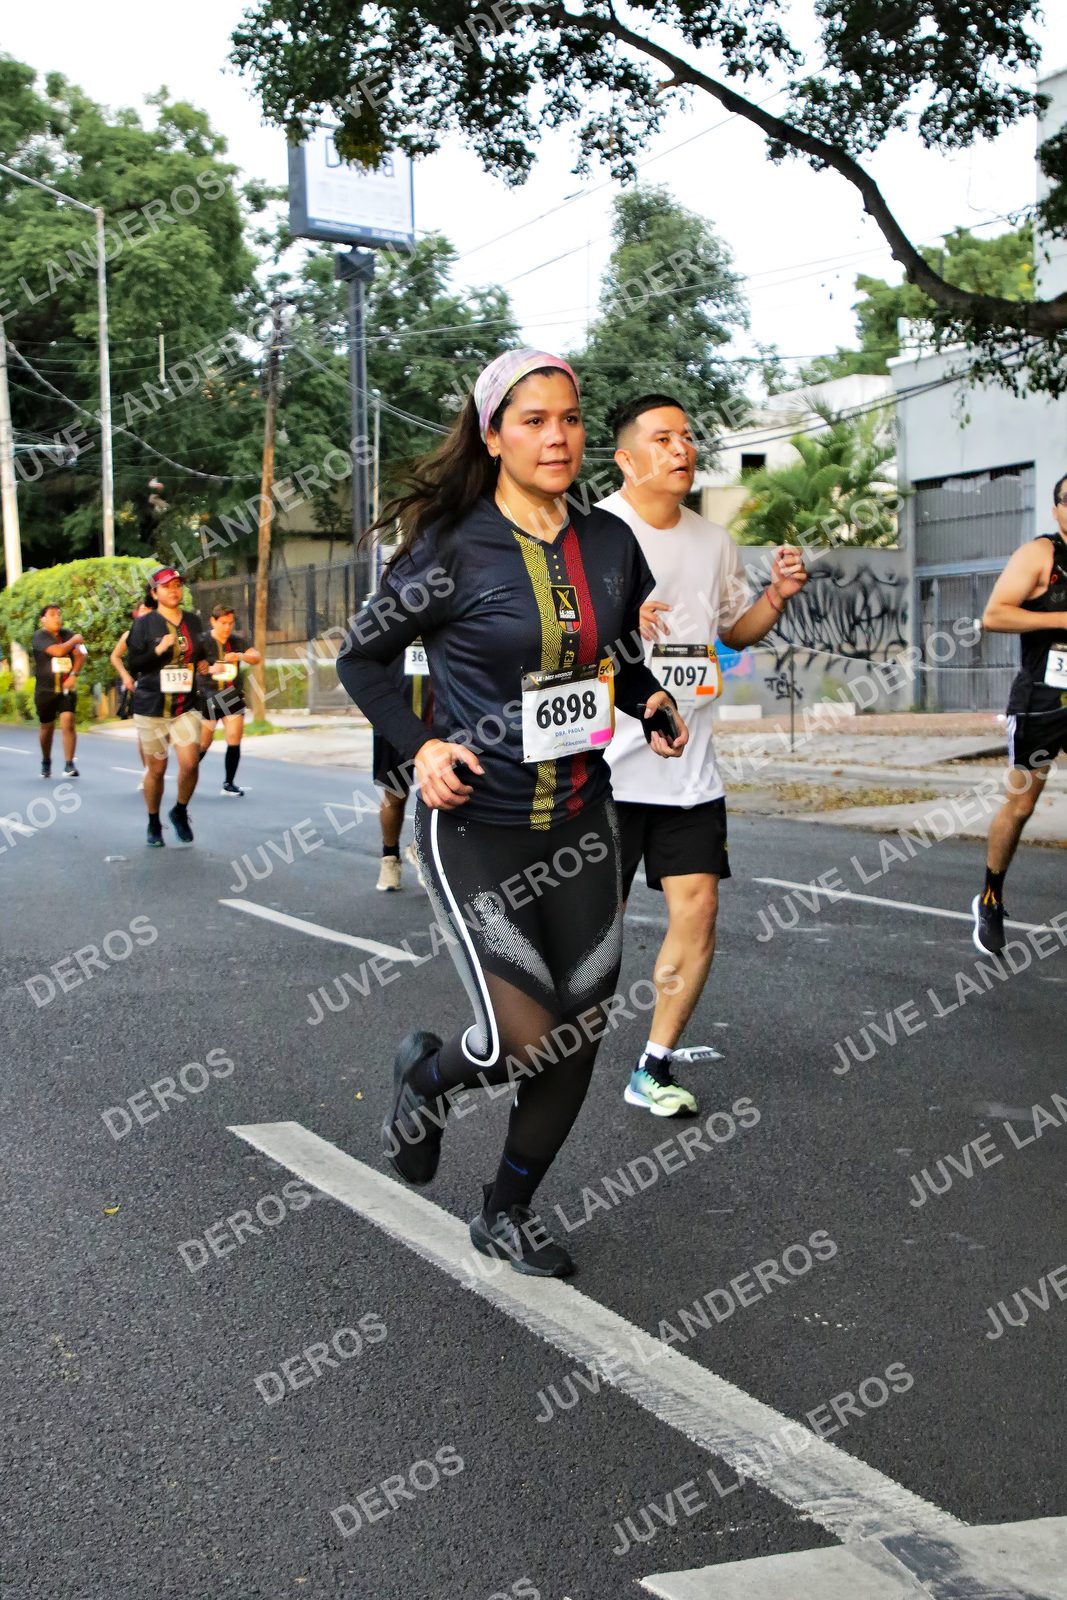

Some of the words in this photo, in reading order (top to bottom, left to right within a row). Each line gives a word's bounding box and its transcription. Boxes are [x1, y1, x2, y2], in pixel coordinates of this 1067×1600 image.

[412, 651, 427, 662] 36
[166, 672, 188, 682] 1319
[662, 665, 707, 687] 7097
[536, 690, 597, 729] 6898
